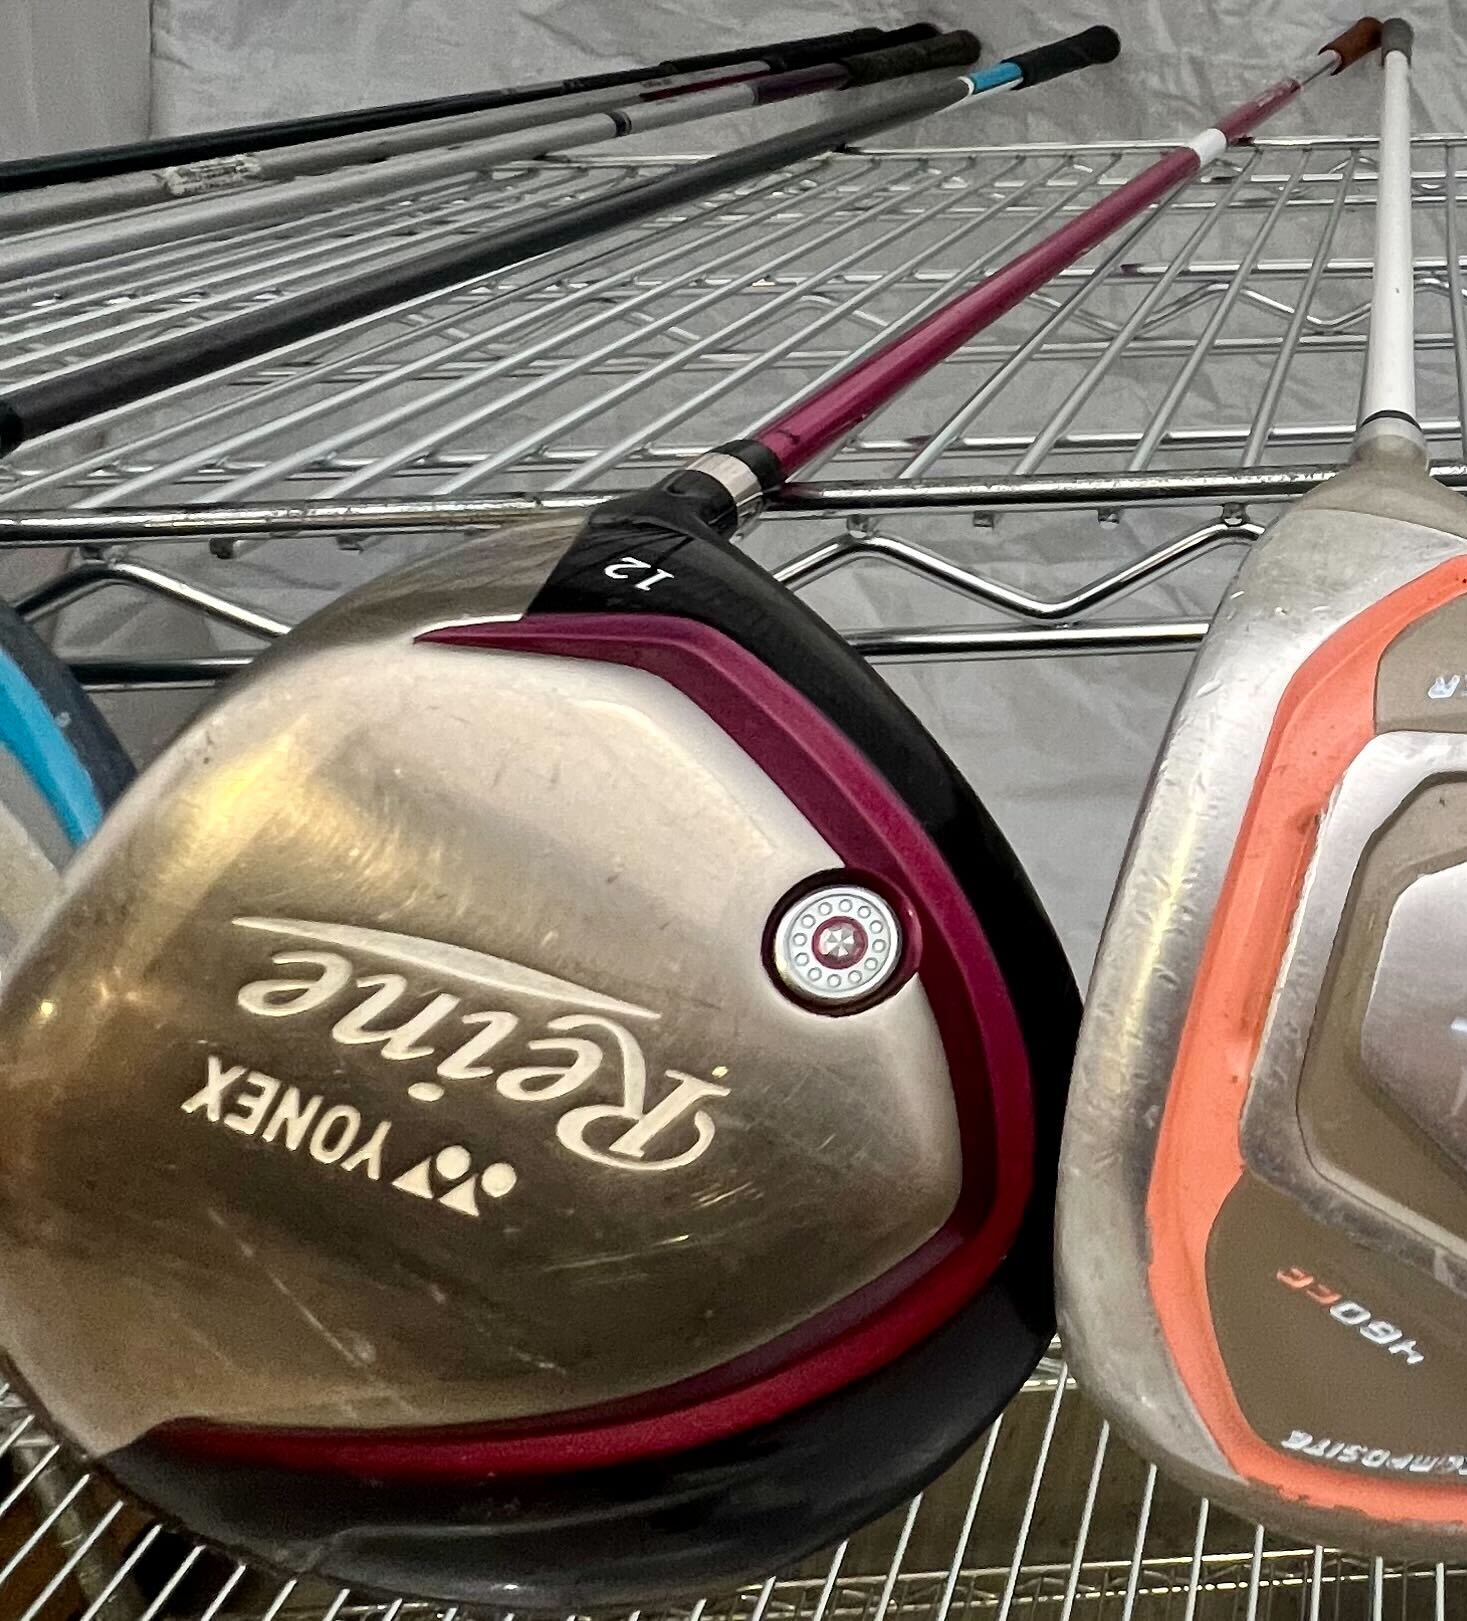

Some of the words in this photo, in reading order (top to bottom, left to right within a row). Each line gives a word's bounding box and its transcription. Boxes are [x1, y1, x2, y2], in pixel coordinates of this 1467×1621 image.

[603, 556, 675, 591] 12
[180, 1054, 393, 1182] YONEX
[236, 949, 732, 1172] Reine
